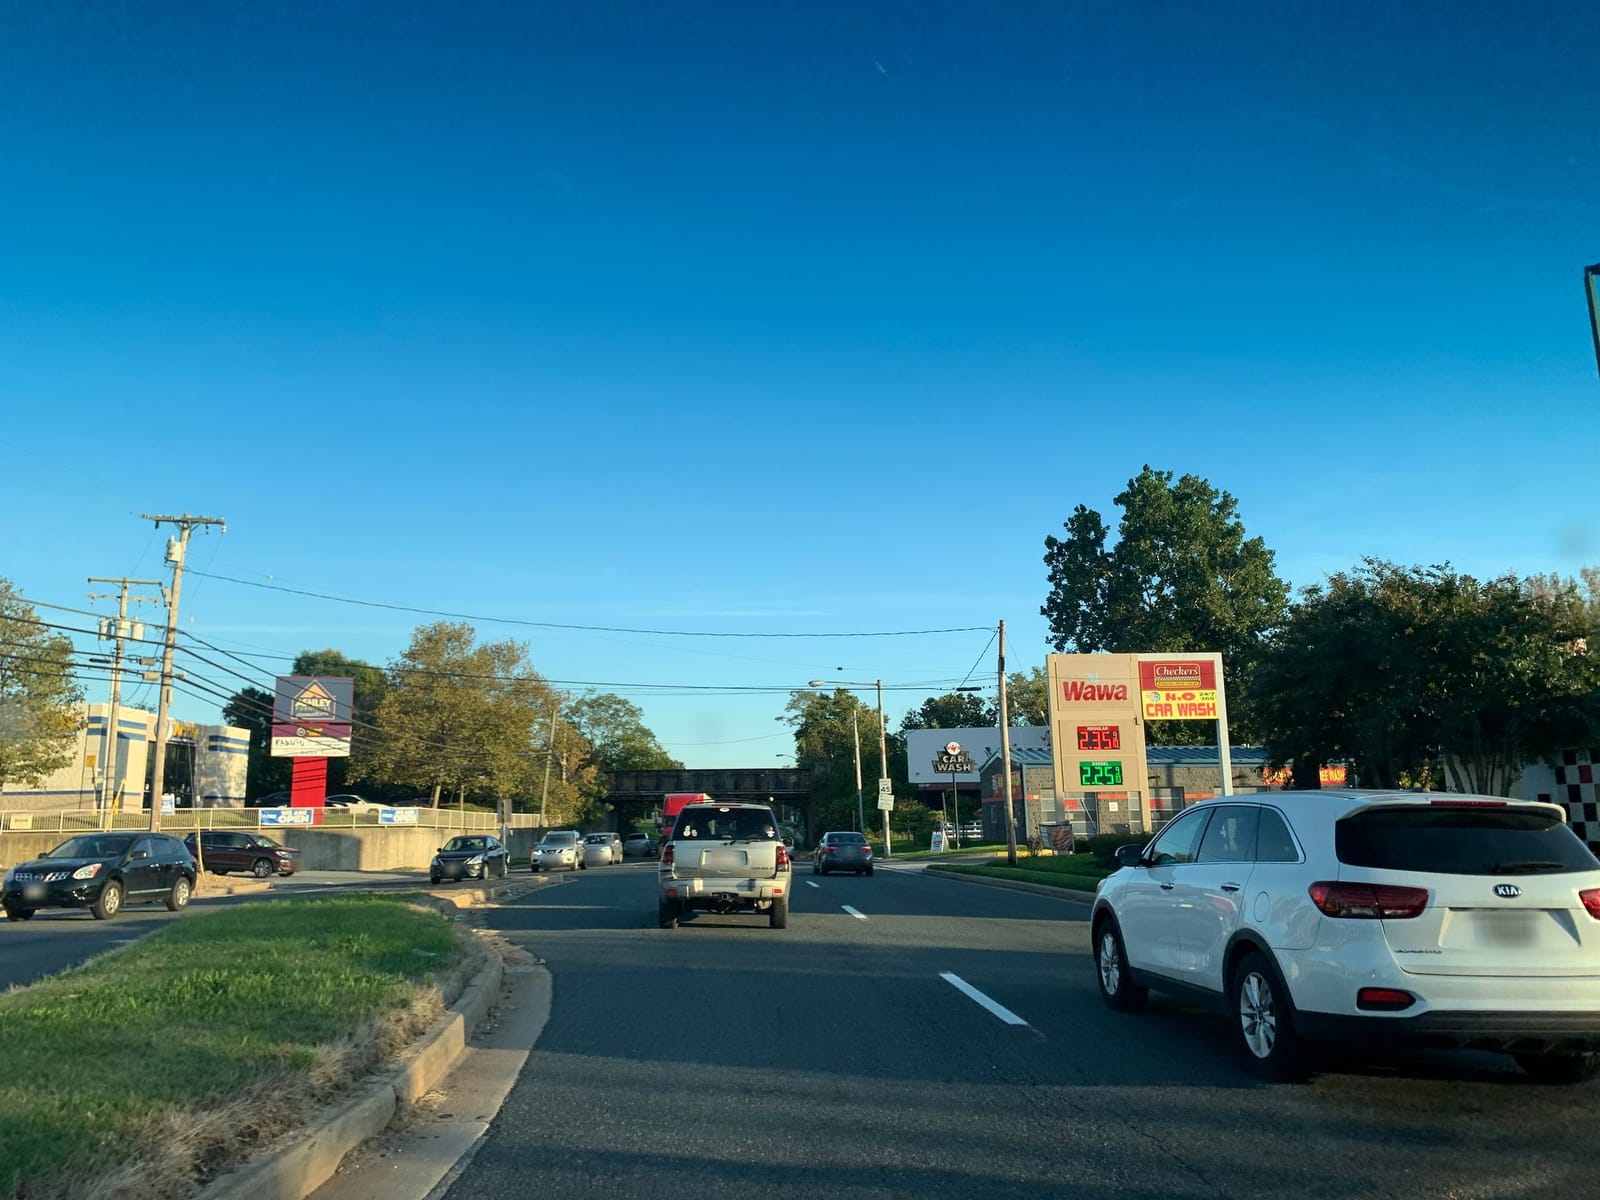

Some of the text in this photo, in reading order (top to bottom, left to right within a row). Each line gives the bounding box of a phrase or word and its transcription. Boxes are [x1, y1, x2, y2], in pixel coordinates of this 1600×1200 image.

[1063, 681, 1127, 701] Wawa
[1146, 703, 1216, 717] CAR WASH
[1080, 731, 1111, 750] 2.35
[942, 755, 965, 763] CAR
[937, 763, 971, 772] WASH
[1082, 766, 1115, 785] 2.25
[1497, 886, 1518, 895] KIA
